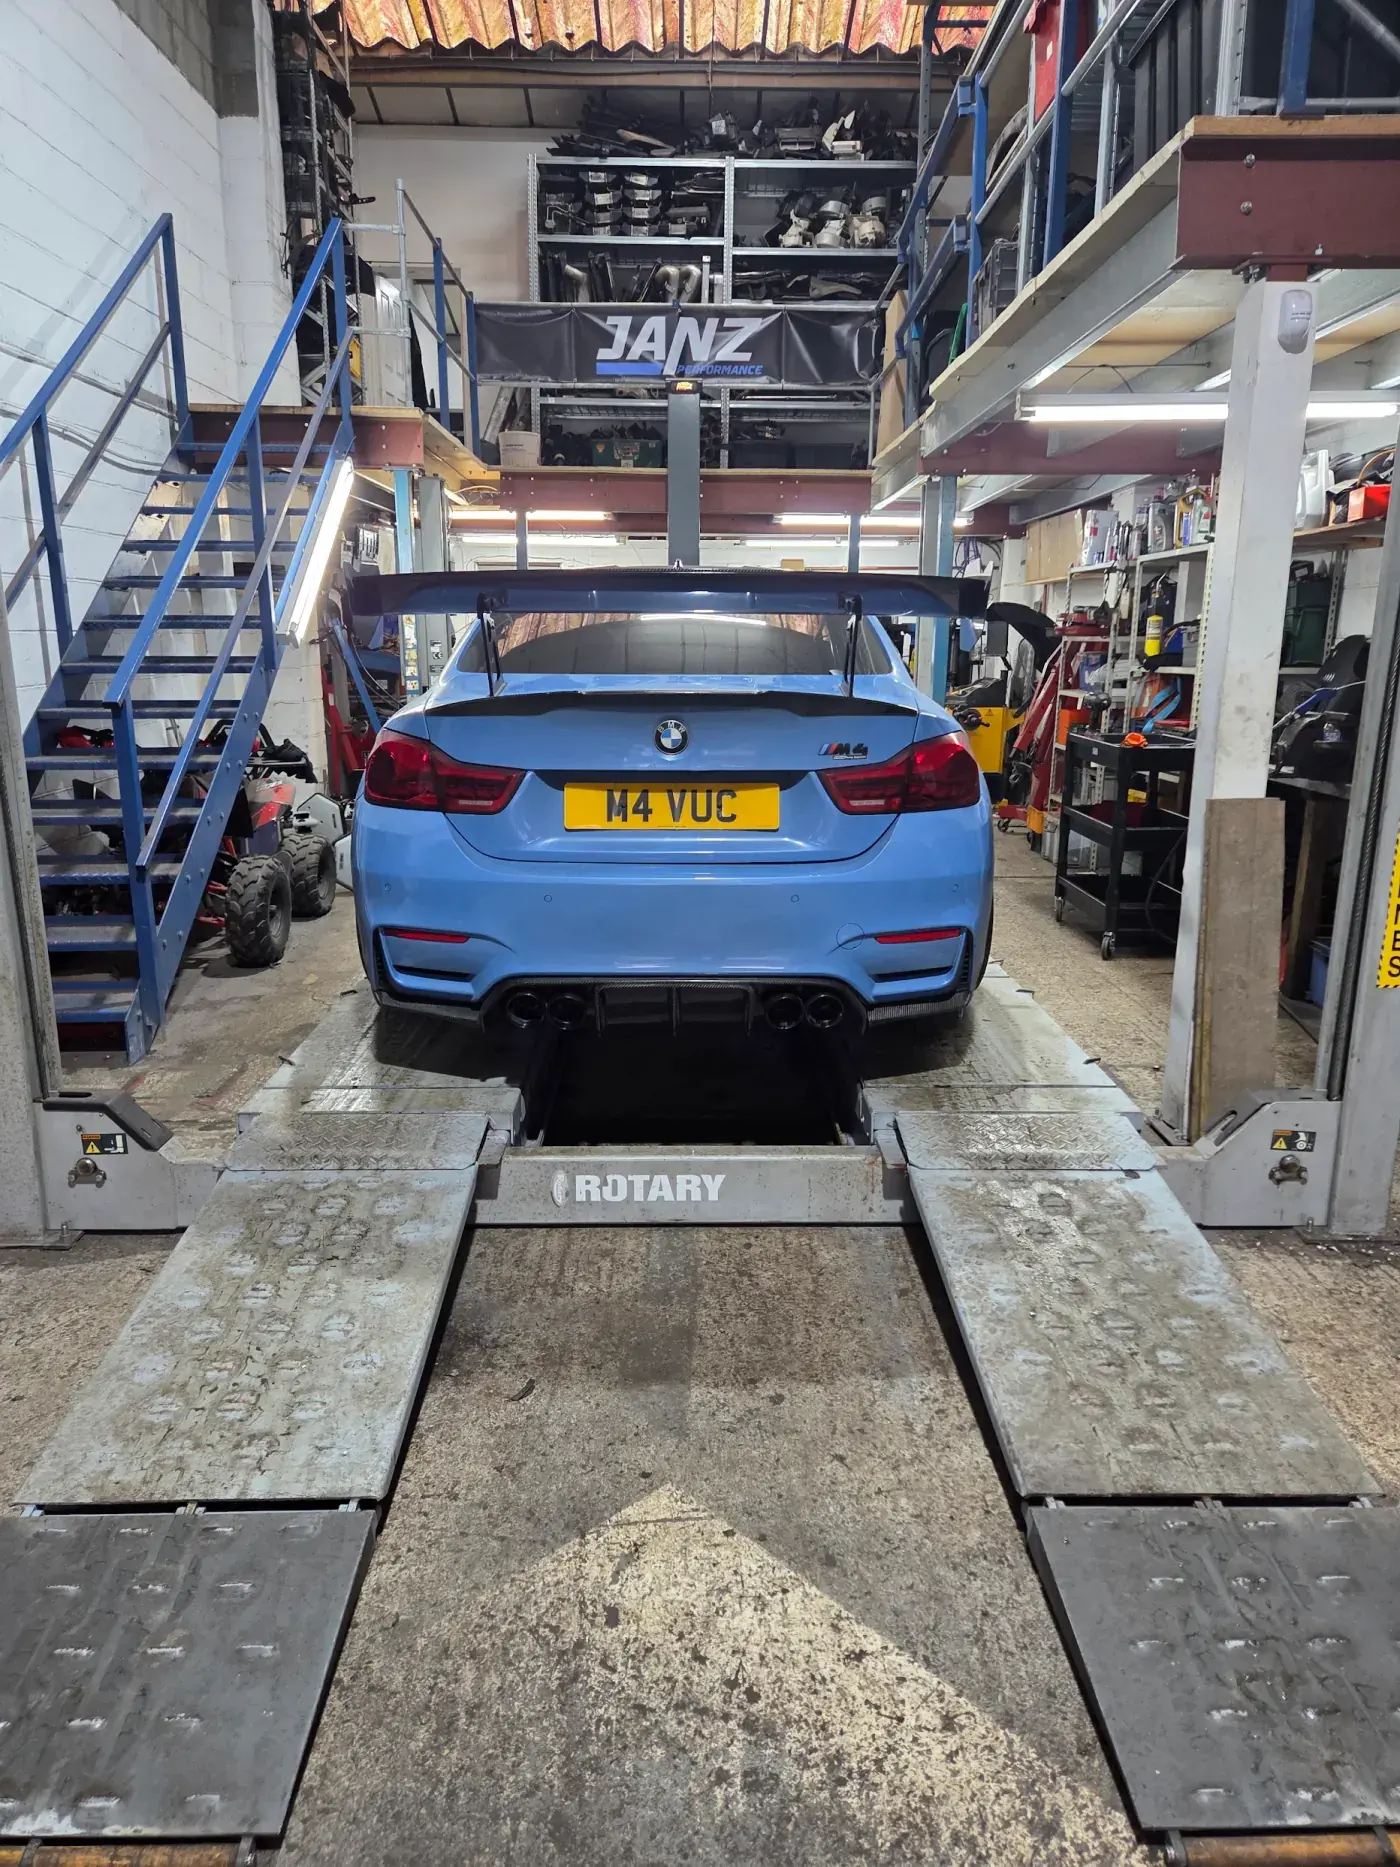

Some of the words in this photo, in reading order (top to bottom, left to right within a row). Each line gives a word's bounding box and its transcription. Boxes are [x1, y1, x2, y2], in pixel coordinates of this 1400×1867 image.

[596, 316, 763, 375] JANZ
[677, 365, 763, 375] PERFORMANCE
[658, 721, 686, 733] BMW
[606, 789, 653, 823] M4
[666, 789, 738, 823] VUC
[575, 1174, 727, 1202] ROTARY
